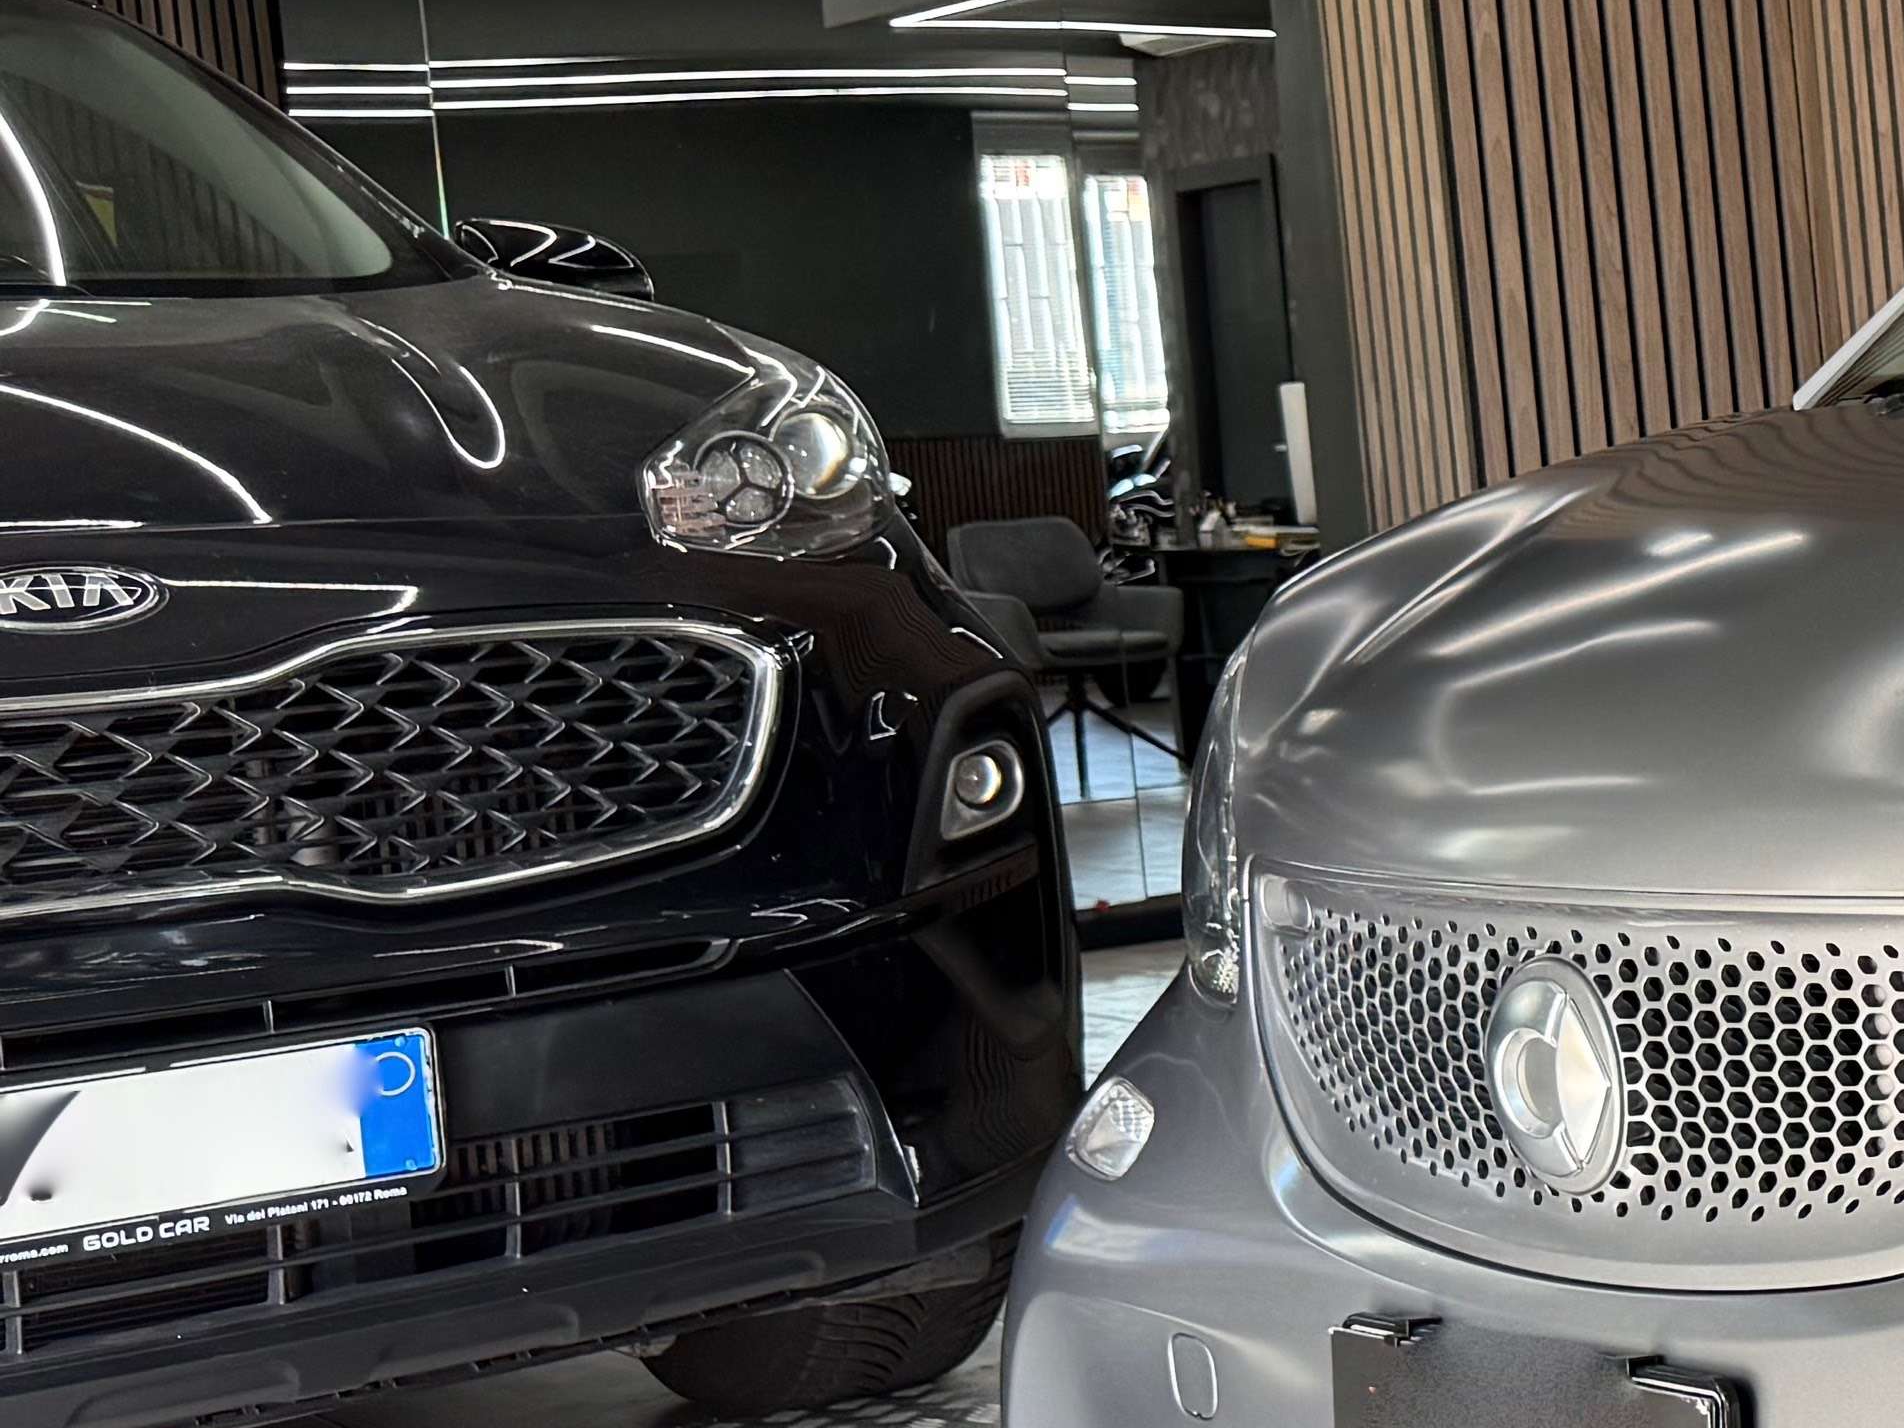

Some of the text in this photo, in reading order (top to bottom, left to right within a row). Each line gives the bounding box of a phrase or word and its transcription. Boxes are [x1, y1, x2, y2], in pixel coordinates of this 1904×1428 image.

[0, 573, 134, 615] KIA
[83, 1226, 154, 1251] GOLD
[159, 1216, 210, 1238] CAR
[225, 1214, 245, 1225] Via
[246, 1208, 266, 1221] dei
[310, 1198, 329, 1211] 171
[374, 1186, 407, 1200] Roma
